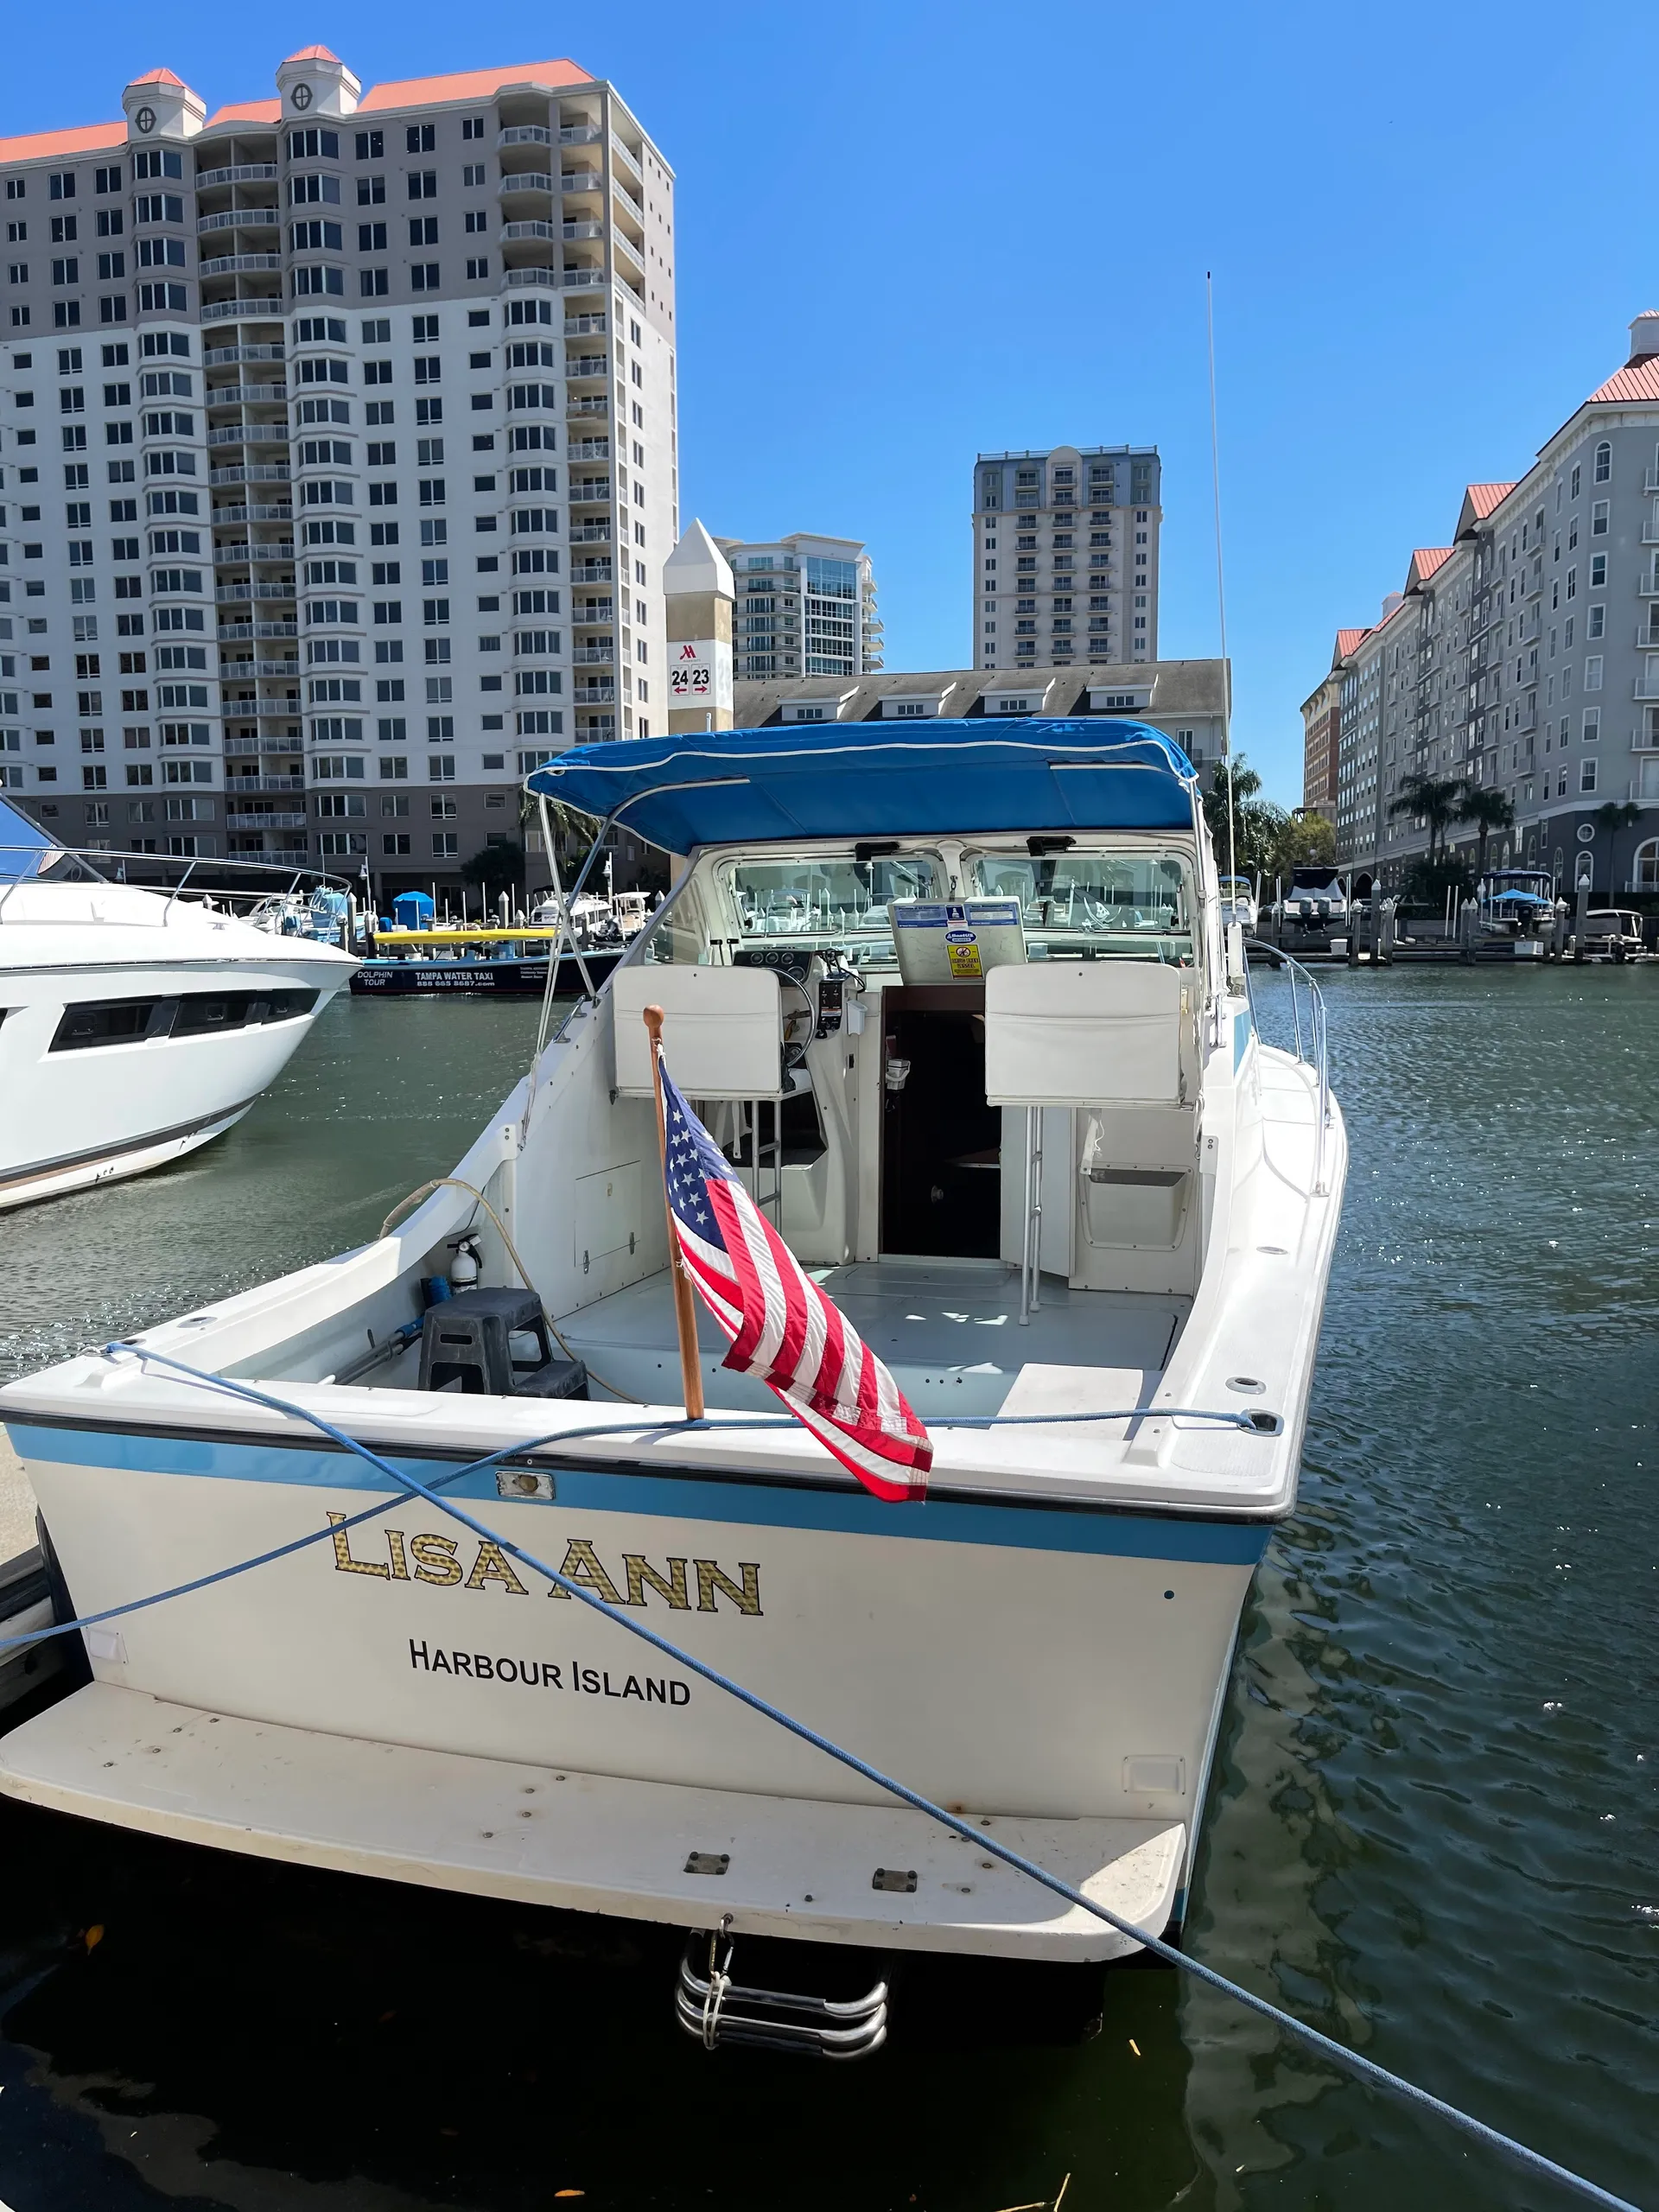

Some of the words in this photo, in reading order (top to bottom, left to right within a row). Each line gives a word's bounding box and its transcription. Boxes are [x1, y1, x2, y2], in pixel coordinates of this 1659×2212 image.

[671, 670, 688, 685] 24
[692, 669, 709, 684] 23
[415, 972, 442, 981] TAMPA
[443, 971, 473, 981] WATER
[474, 972, 493, 981] TAXI
[326, 1510, 530, 1596] LISA
[547, 1538, 765, 1617] ANN
[410, 1638, 564, 1690] HARBOUR
[572, 1660, 691, 1707] ISLAND
